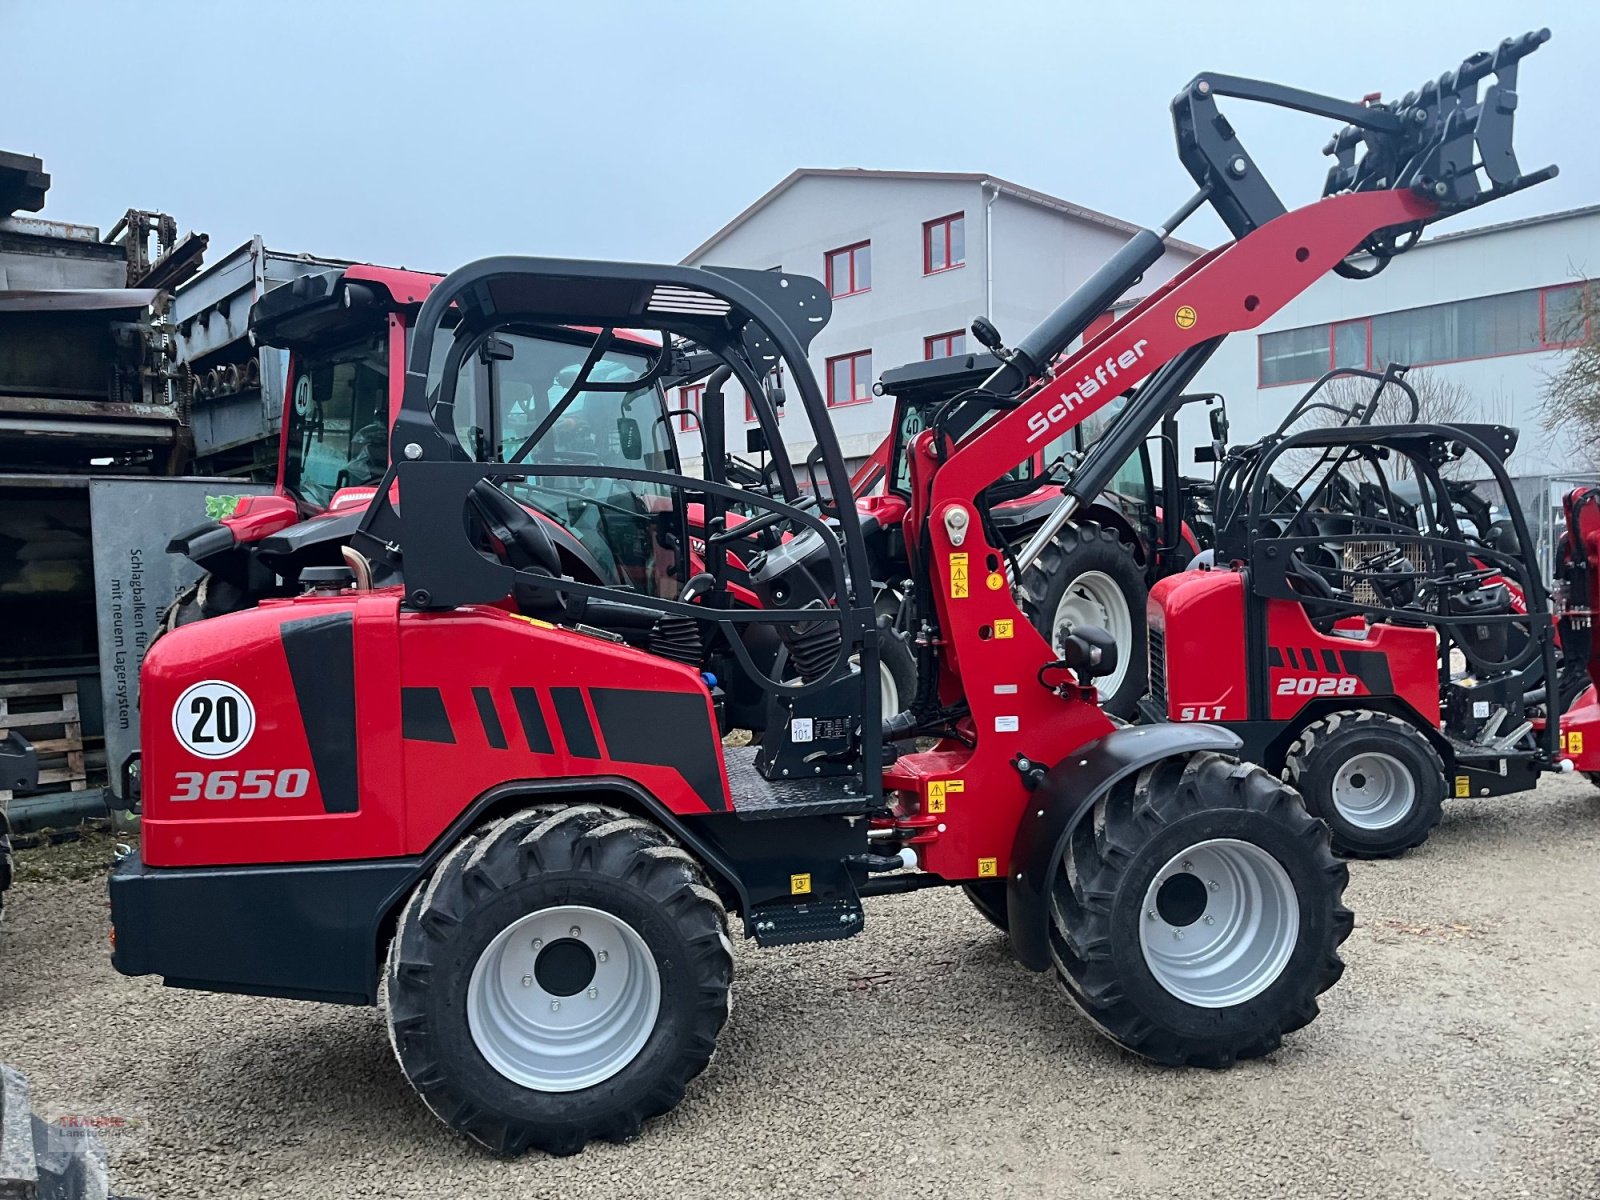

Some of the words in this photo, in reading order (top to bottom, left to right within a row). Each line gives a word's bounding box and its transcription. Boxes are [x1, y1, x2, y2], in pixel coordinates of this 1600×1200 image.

[298, 382, 308, 408] 40
[1026, 339, 1148, 443] Schäffer
[906, 418, 919, 436] 40
[111, 579, 125, 600] mit
[130, 549, 147, 628] Schlagbalken
[112, 605, 127, 648] neuem
[135, 631, 148, 649] für
[113, 651, 130, 730] Lagersystem
[1276, 677, 1358, 696] 2028
[190, 695, 239, 744] 20
[1180, 706, 1226, 721] SLT
[169, 768, 311, 802] 3650
